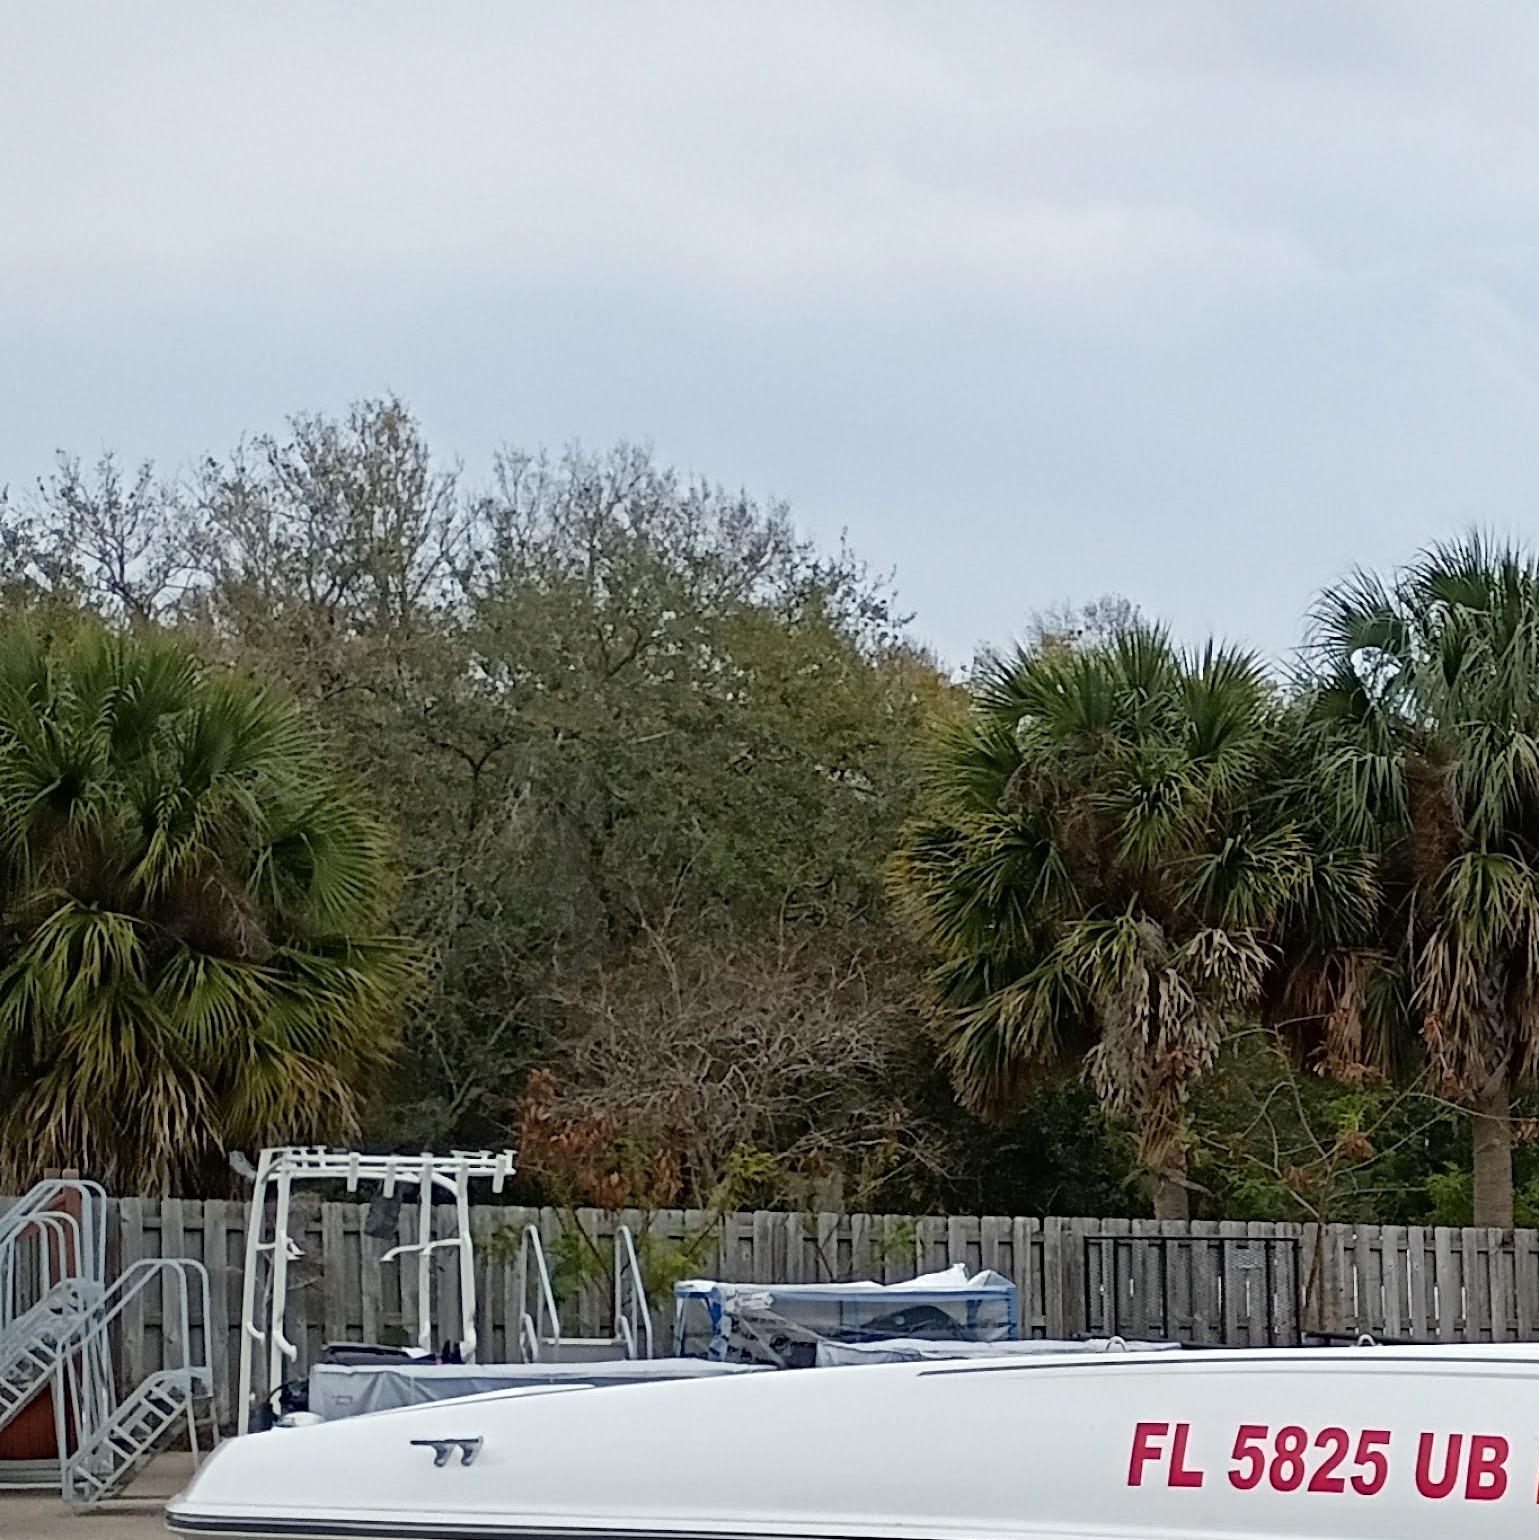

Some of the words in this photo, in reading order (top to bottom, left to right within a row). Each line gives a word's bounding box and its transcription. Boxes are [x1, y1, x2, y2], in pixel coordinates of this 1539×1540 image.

[1127, 1422, 1204, 1488] FL
[1227, 1424, 1392, 1496] 5825
[1415, 1432, 1510, 1500] UB
